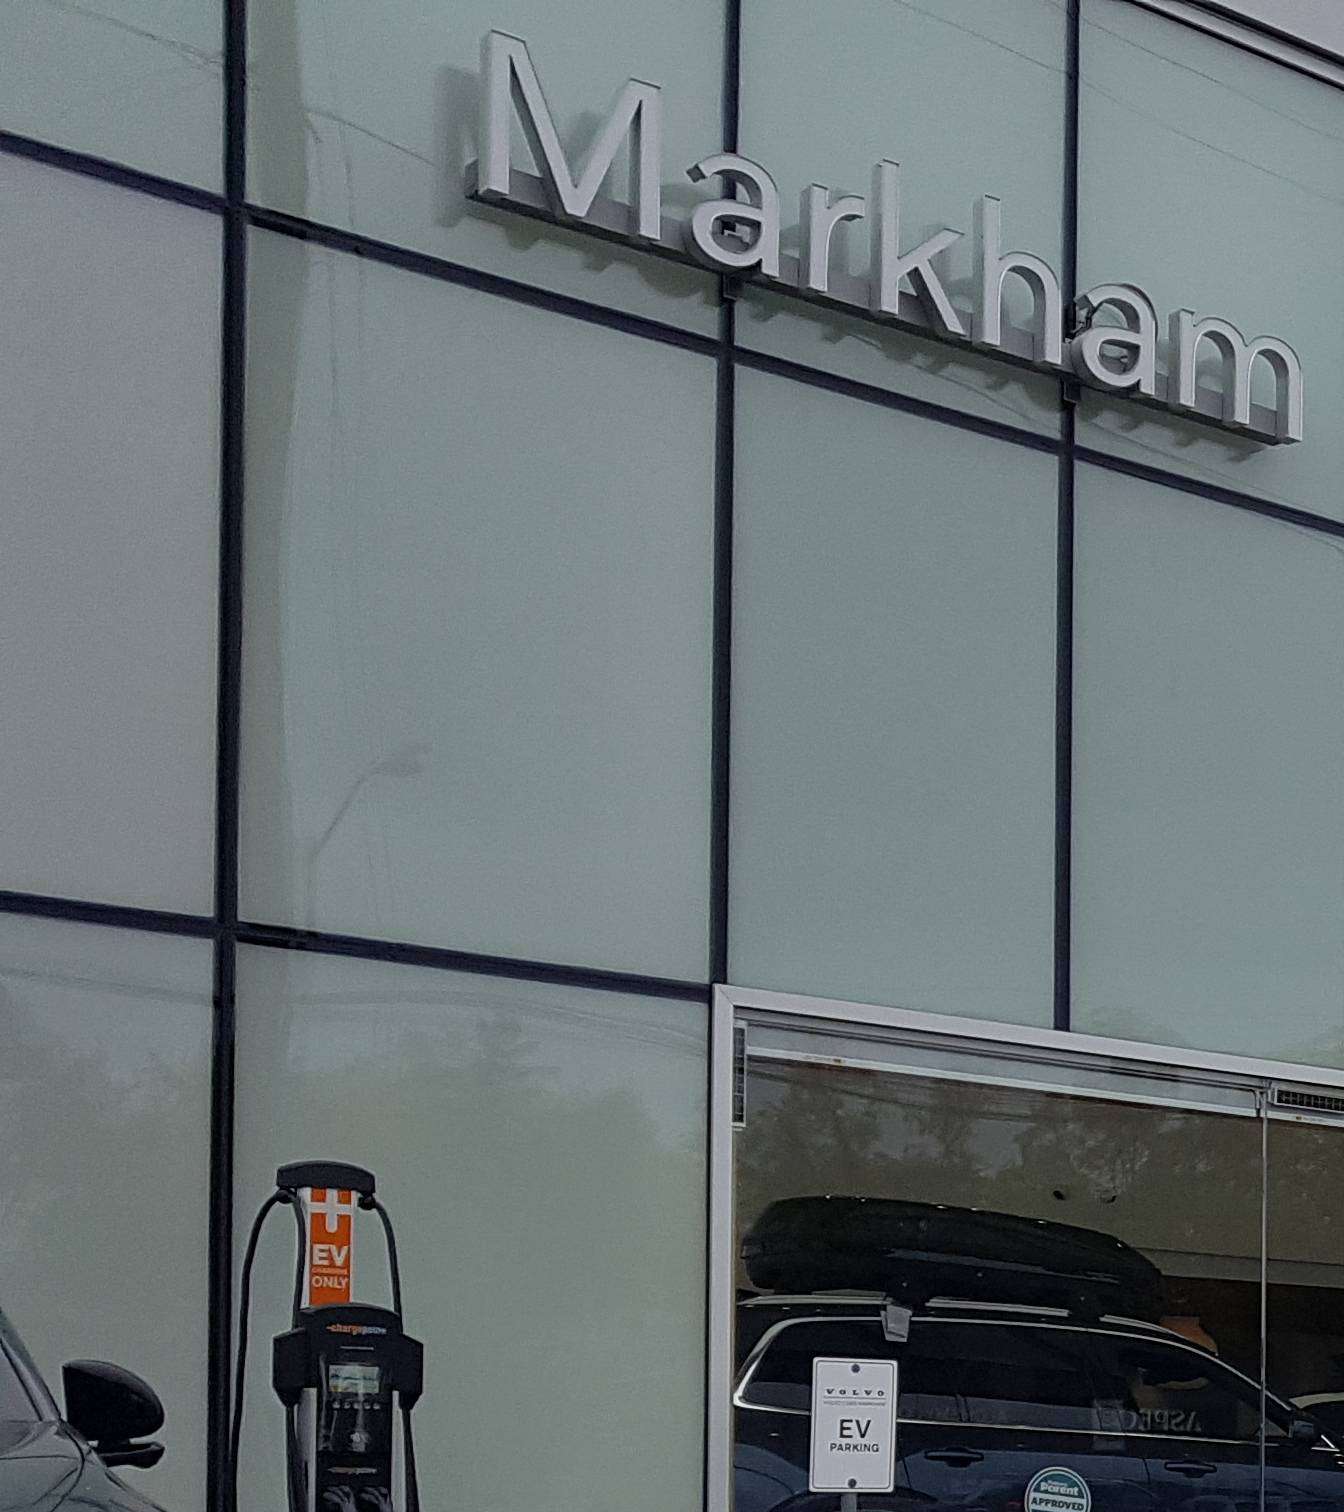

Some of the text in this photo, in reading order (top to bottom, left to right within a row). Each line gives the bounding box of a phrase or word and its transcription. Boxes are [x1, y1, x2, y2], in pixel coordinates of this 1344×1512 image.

[479, 29, 1304, 445] Markham
[312, 1243, 349, 1266] EV
[312, 1275, 349, 1291] ONLY
[825, 1388, 885, 1397] VOLVO
[839, 1418, 871, 1439] EV
[829, 1442, 880, 1453] PARKING
[1040, 1481, 1079, 1496] Parent
[1031, 1497, 1084, 1511] APPROVED
